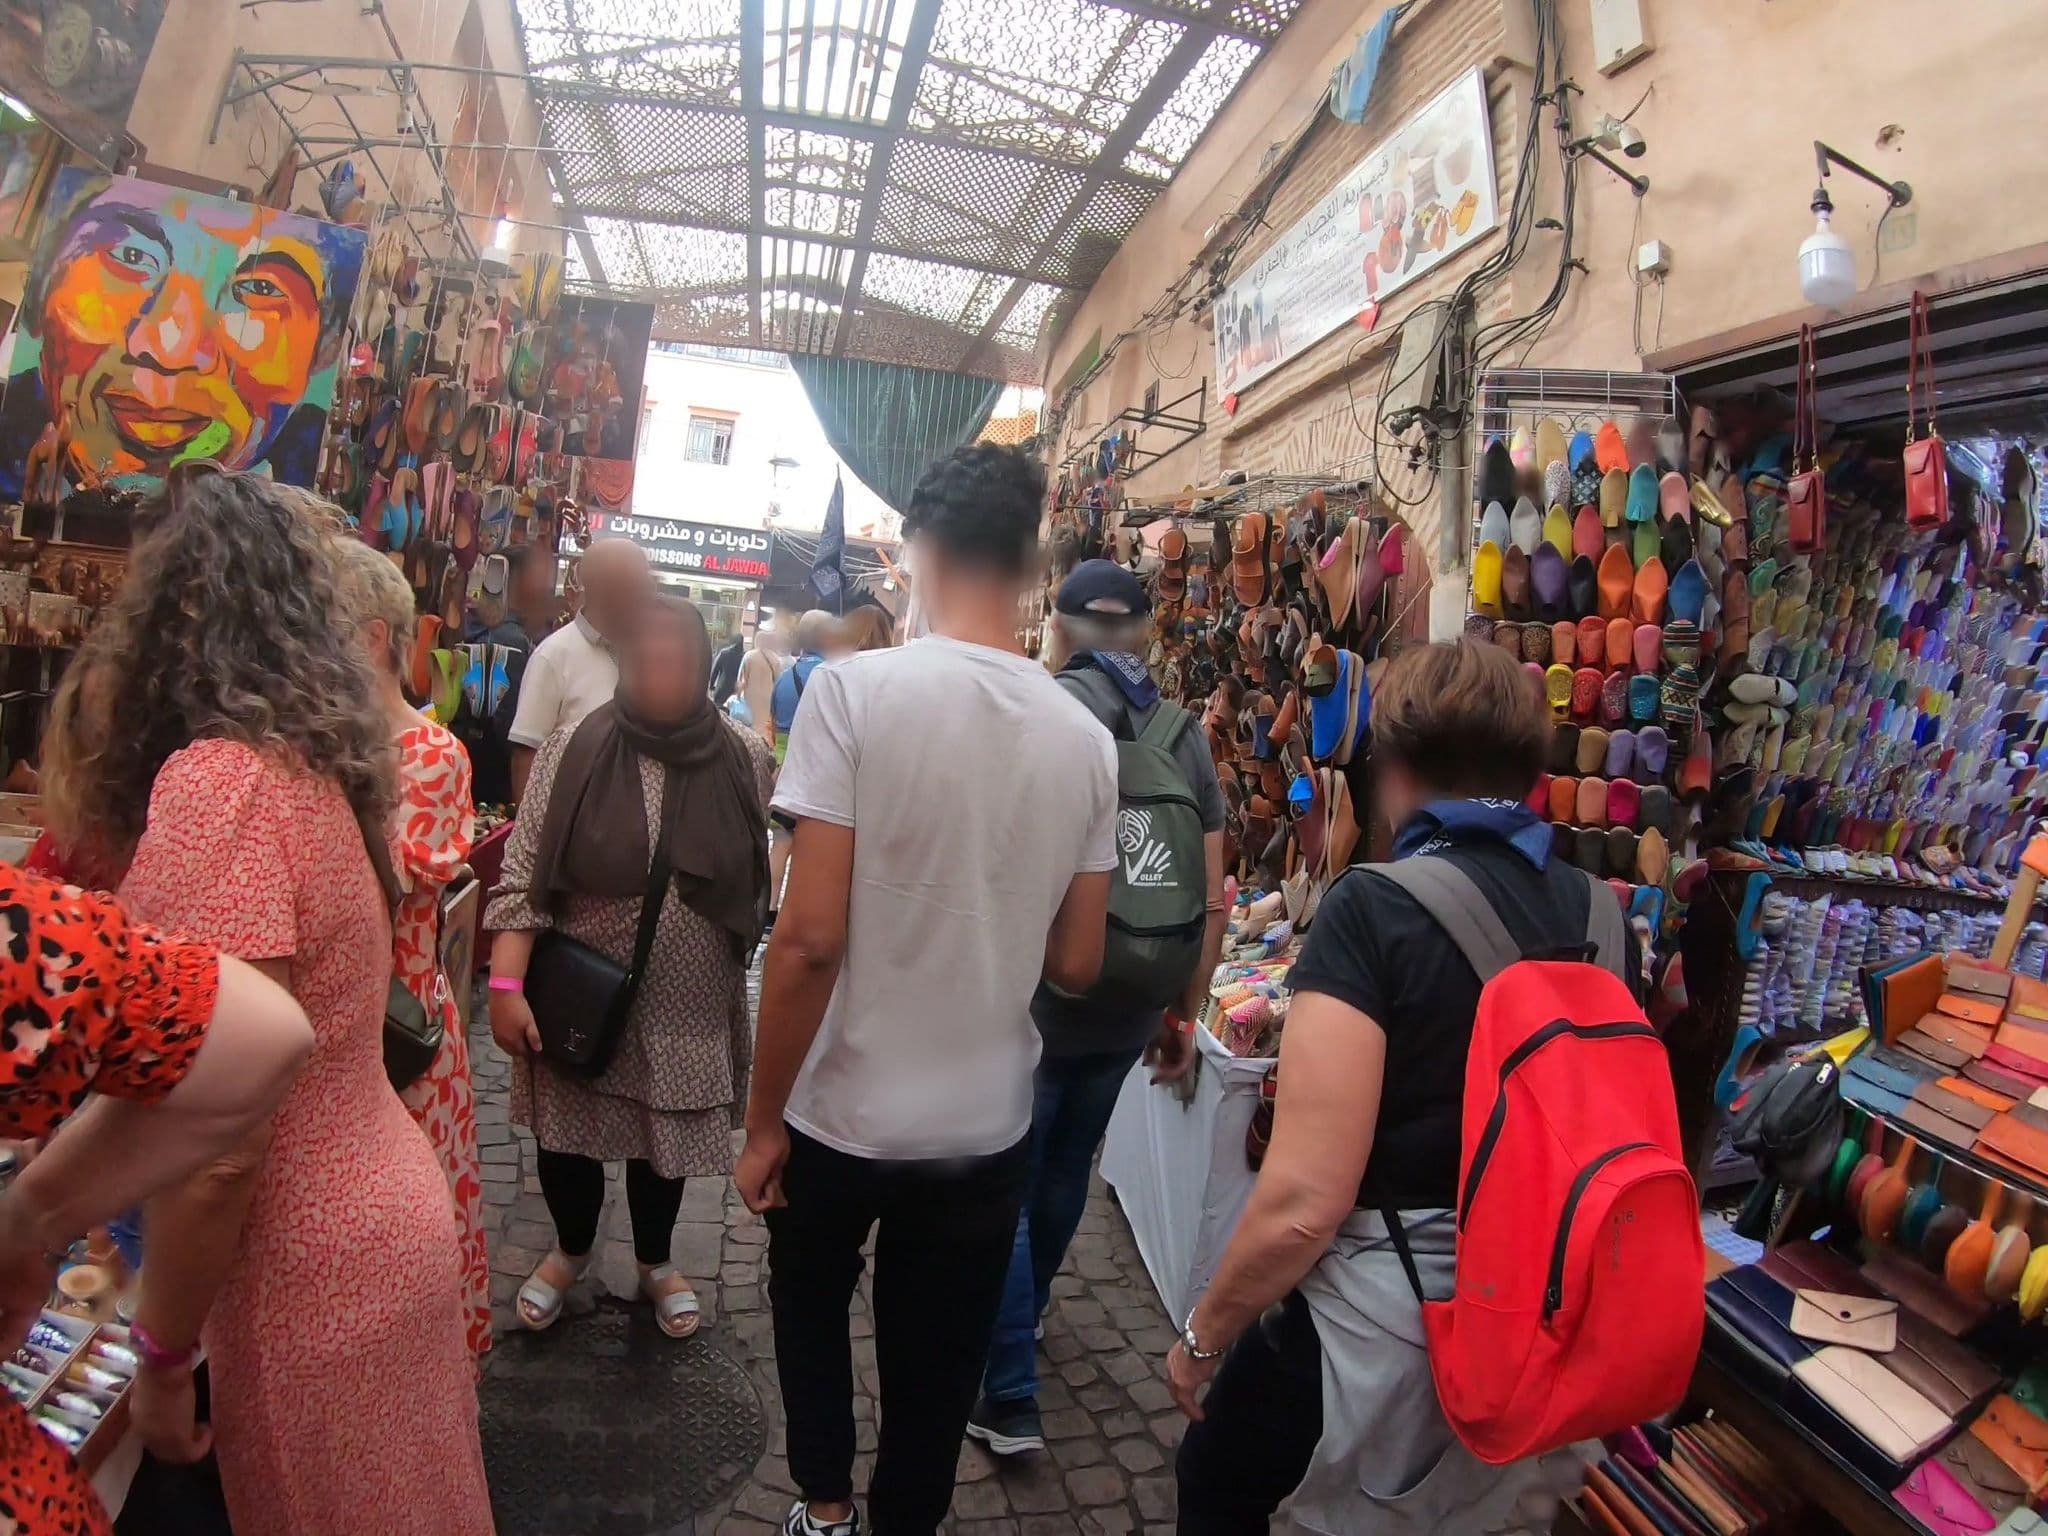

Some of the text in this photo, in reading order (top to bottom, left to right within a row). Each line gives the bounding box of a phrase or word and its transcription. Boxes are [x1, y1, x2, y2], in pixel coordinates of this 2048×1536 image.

[610, 516, 691, 540] مشروبات
[694, 530, 705, 547] و
[709, 527, 768, 552] حلويات
[642, 547, 769, 576] OISSONS AL JAWDA
